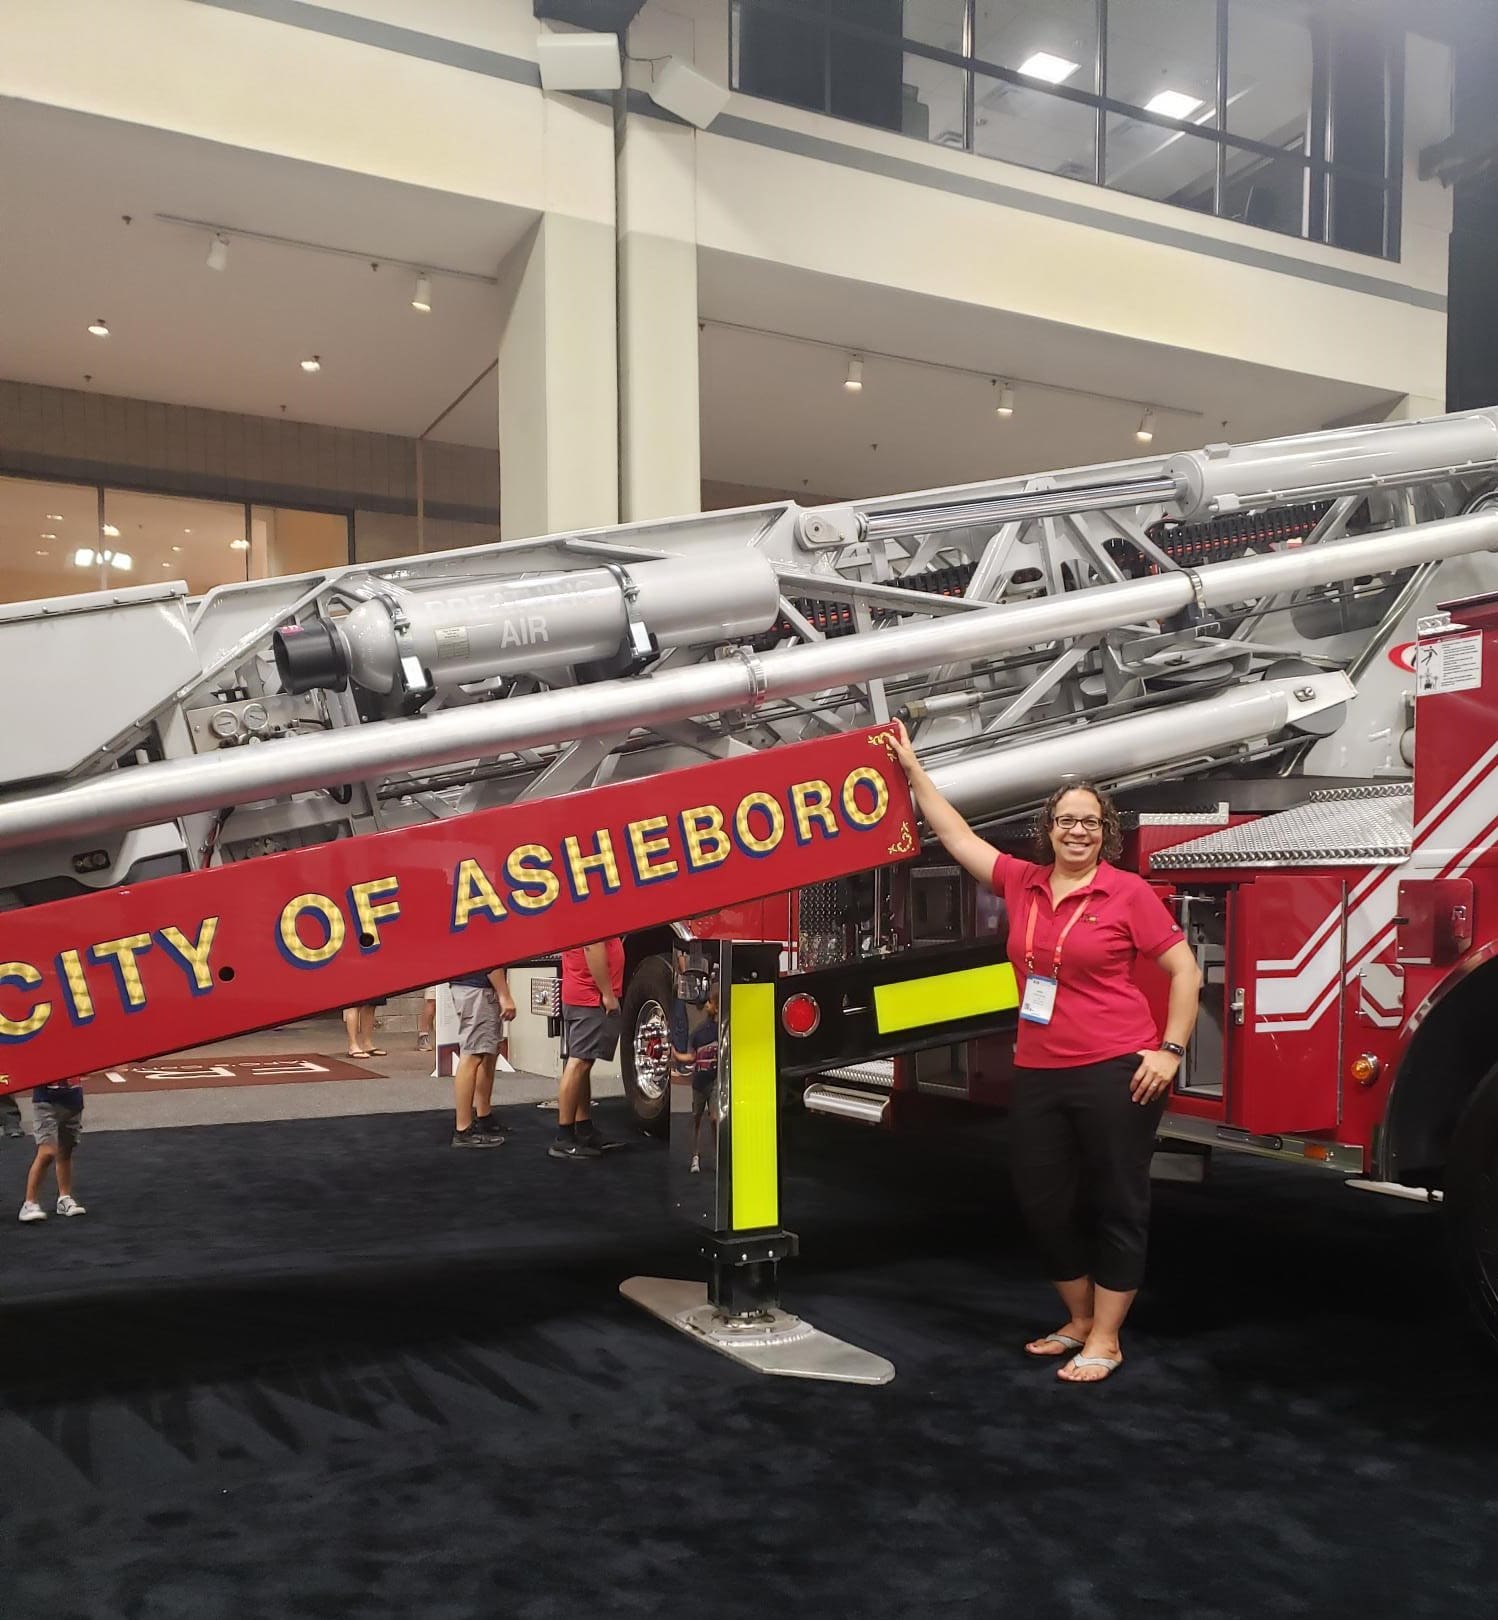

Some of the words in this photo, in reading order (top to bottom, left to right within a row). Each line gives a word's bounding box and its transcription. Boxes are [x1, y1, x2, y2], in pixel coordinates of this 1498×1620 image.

[501, 616, 549, 648] AIR
[0, 917, 218, 1043] CITY
[275, 876, 400, 969] OF
[450, 766, 889, 932] ASHEBORO
